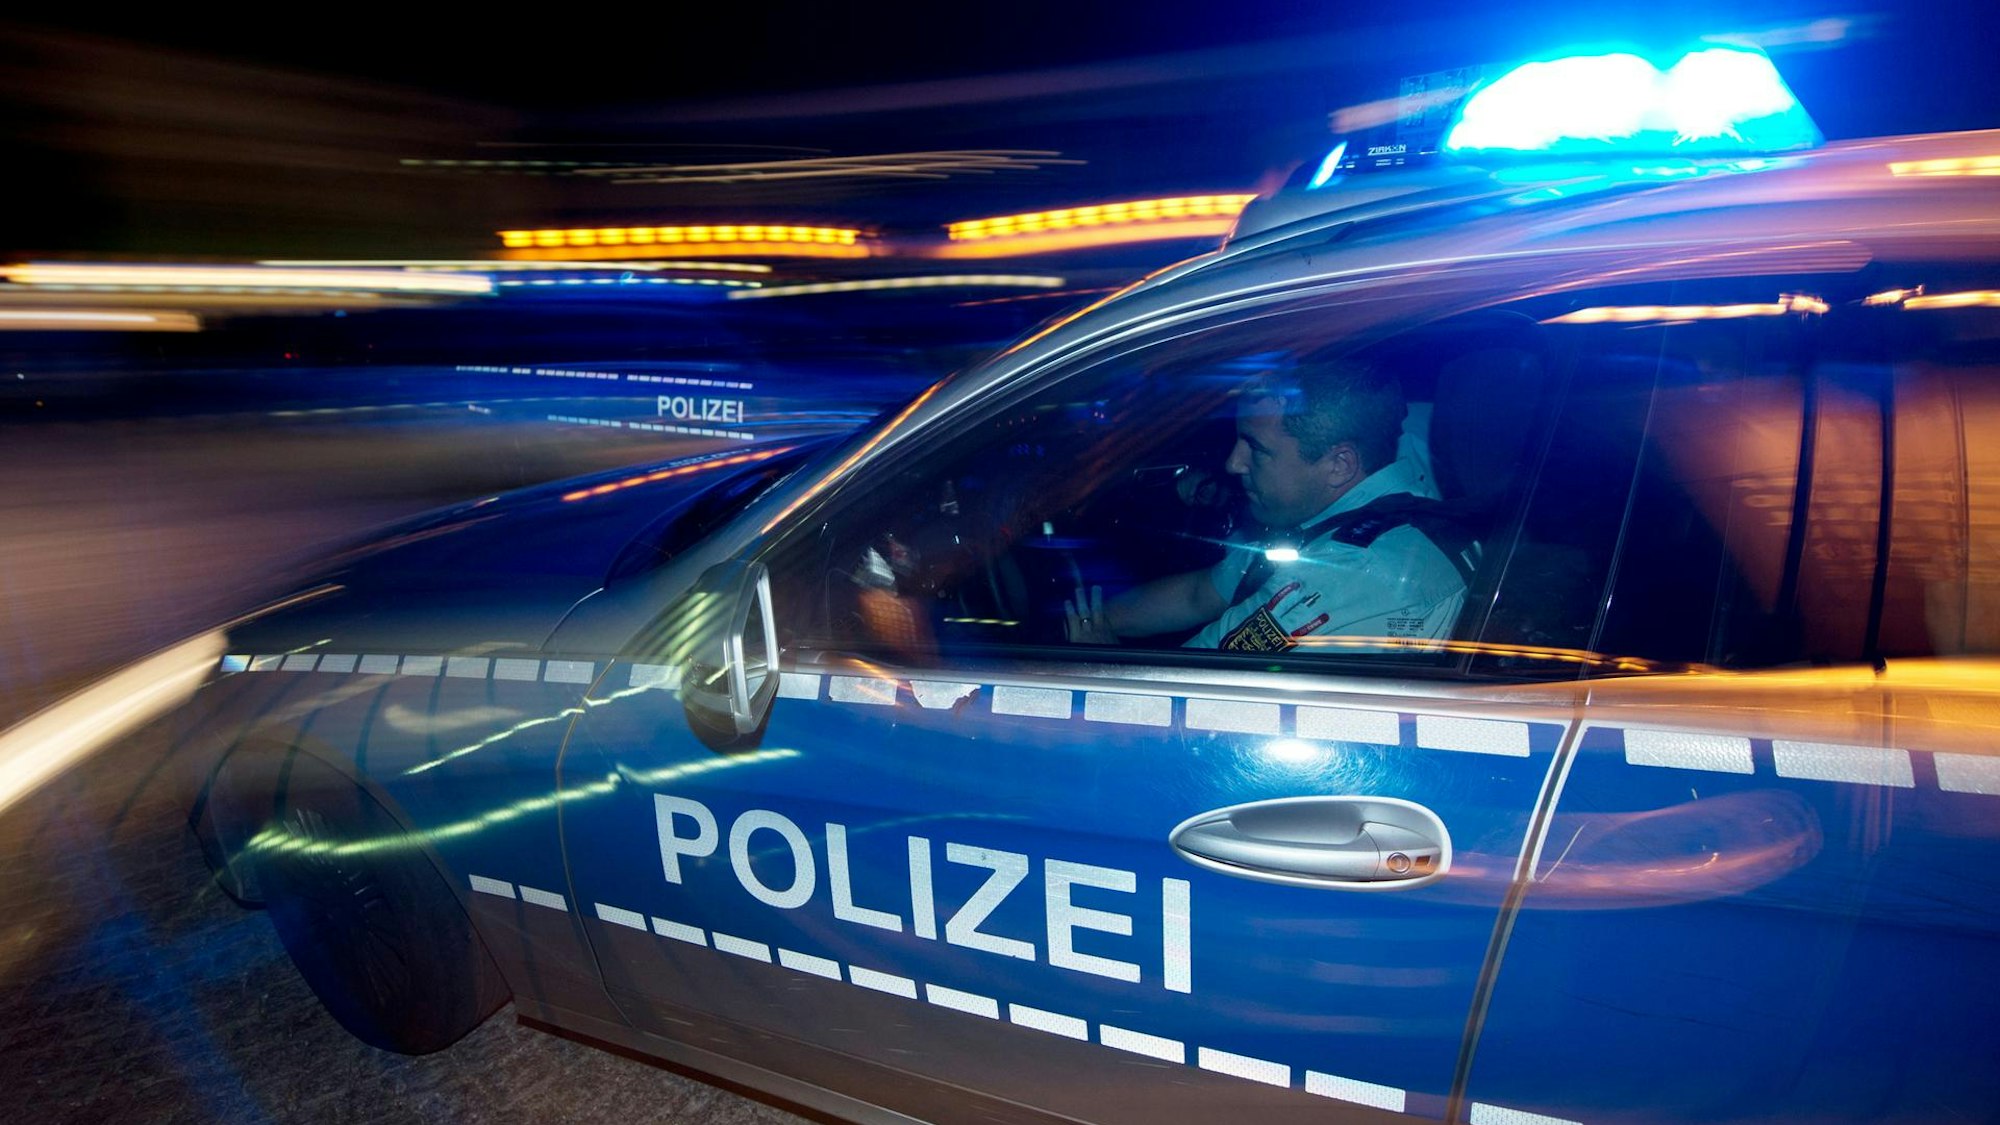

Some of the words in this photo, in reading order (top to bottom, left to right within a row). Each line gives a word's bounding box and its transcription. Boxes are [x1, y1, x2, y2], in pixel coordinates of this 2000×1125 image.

[657, 396, 744, 423] POLIZEI
[1257, 614, 1283, 647] POLIZEI
[653, 793, 1191, 994] POLIZEI
